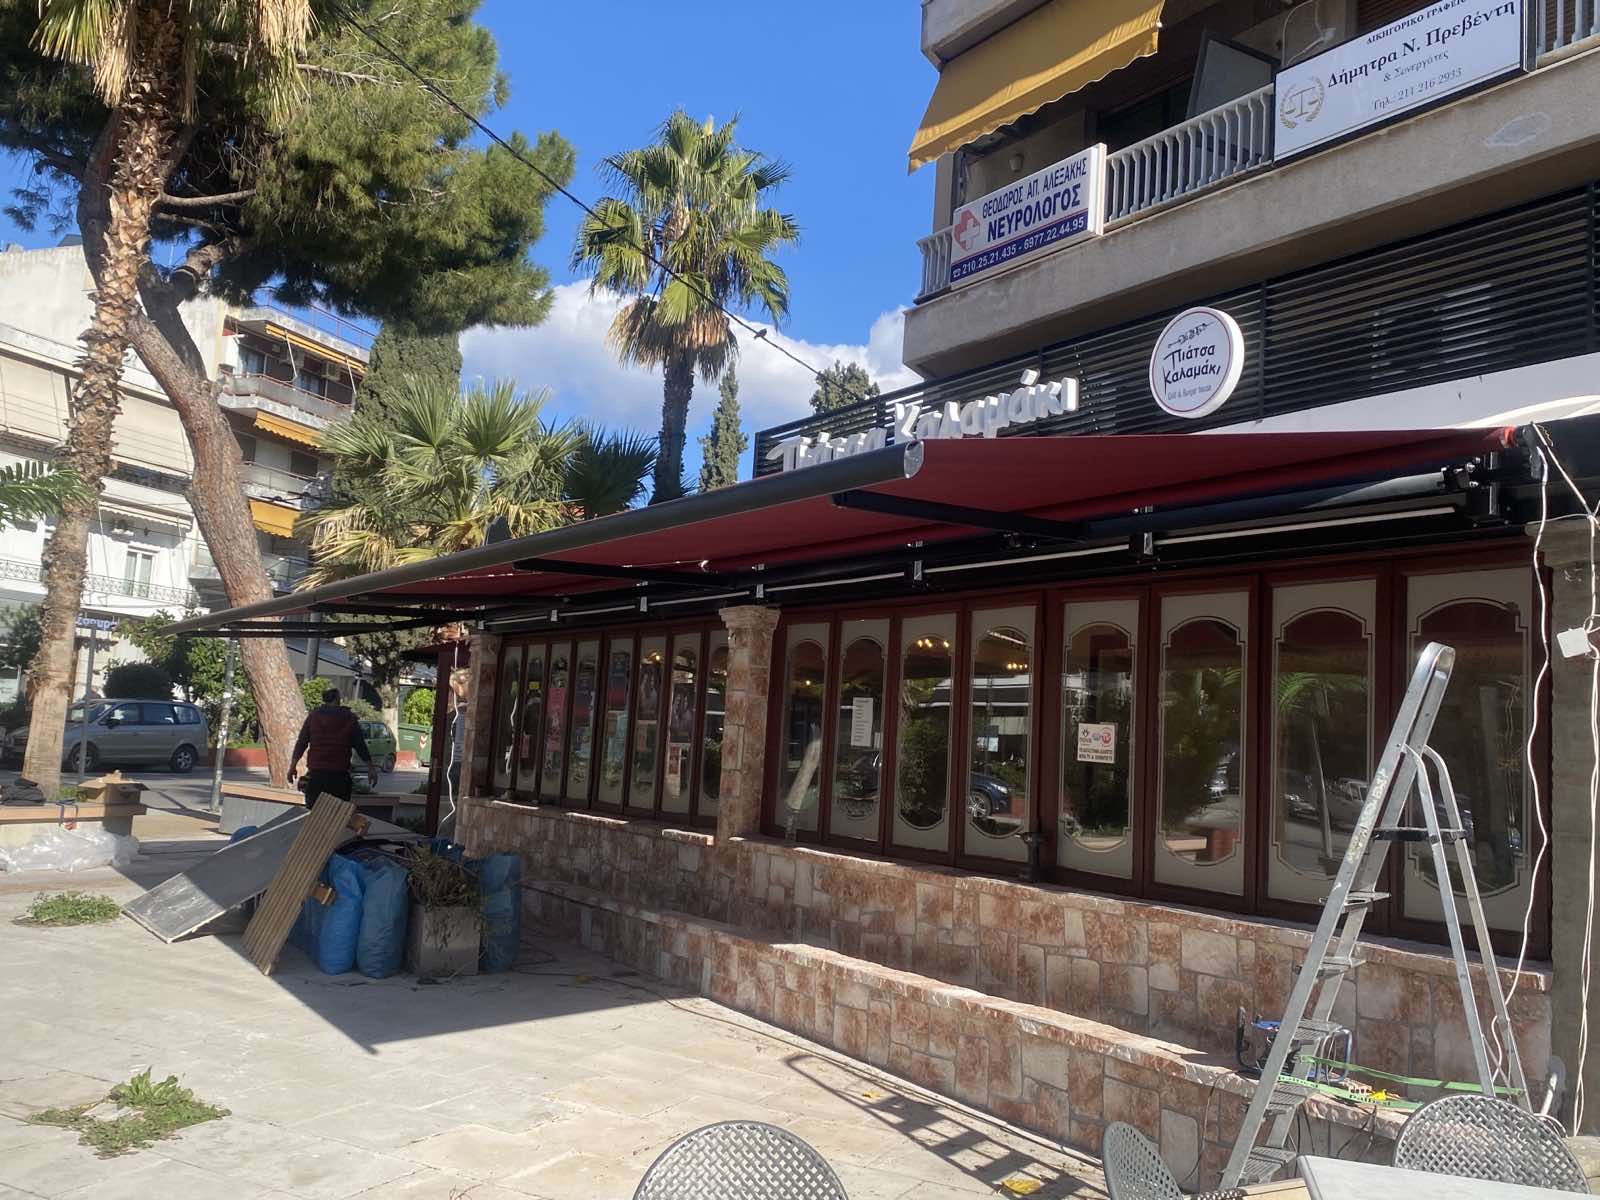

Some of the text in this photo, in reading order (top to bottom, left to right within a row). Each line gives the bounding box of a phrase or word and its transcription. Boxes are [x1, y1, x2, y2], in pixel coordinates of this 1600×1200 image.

[1328, 51, 1397, 88] Δήμητρα
[1426, 2, 1515, 46] Πρεβέντη
[1367, 15, 1424, 45] ΔΙΚΗΓΟΡΙΚΟ
[1383, 73, 1392, 83] &
[983, 157, 1087, 219] ΘΕΟΔΩΡΟΣ ΑΠ. ΑΛΕΞΑΚΗΣ
[987, 183, 1081, 243] ΝΕΥΡΟΛΟΓΟΣ
[962, 244, 1017, 274] 210.25.21.435
[1024, 217, 1085, 249] 6977.22.44.95
[1162, 360, 1221, 396] Καλαμάκι
[1163, 344, 1216, 370] Πιάτσα
[895, 368, 1079, 444] Καλαμάκι
